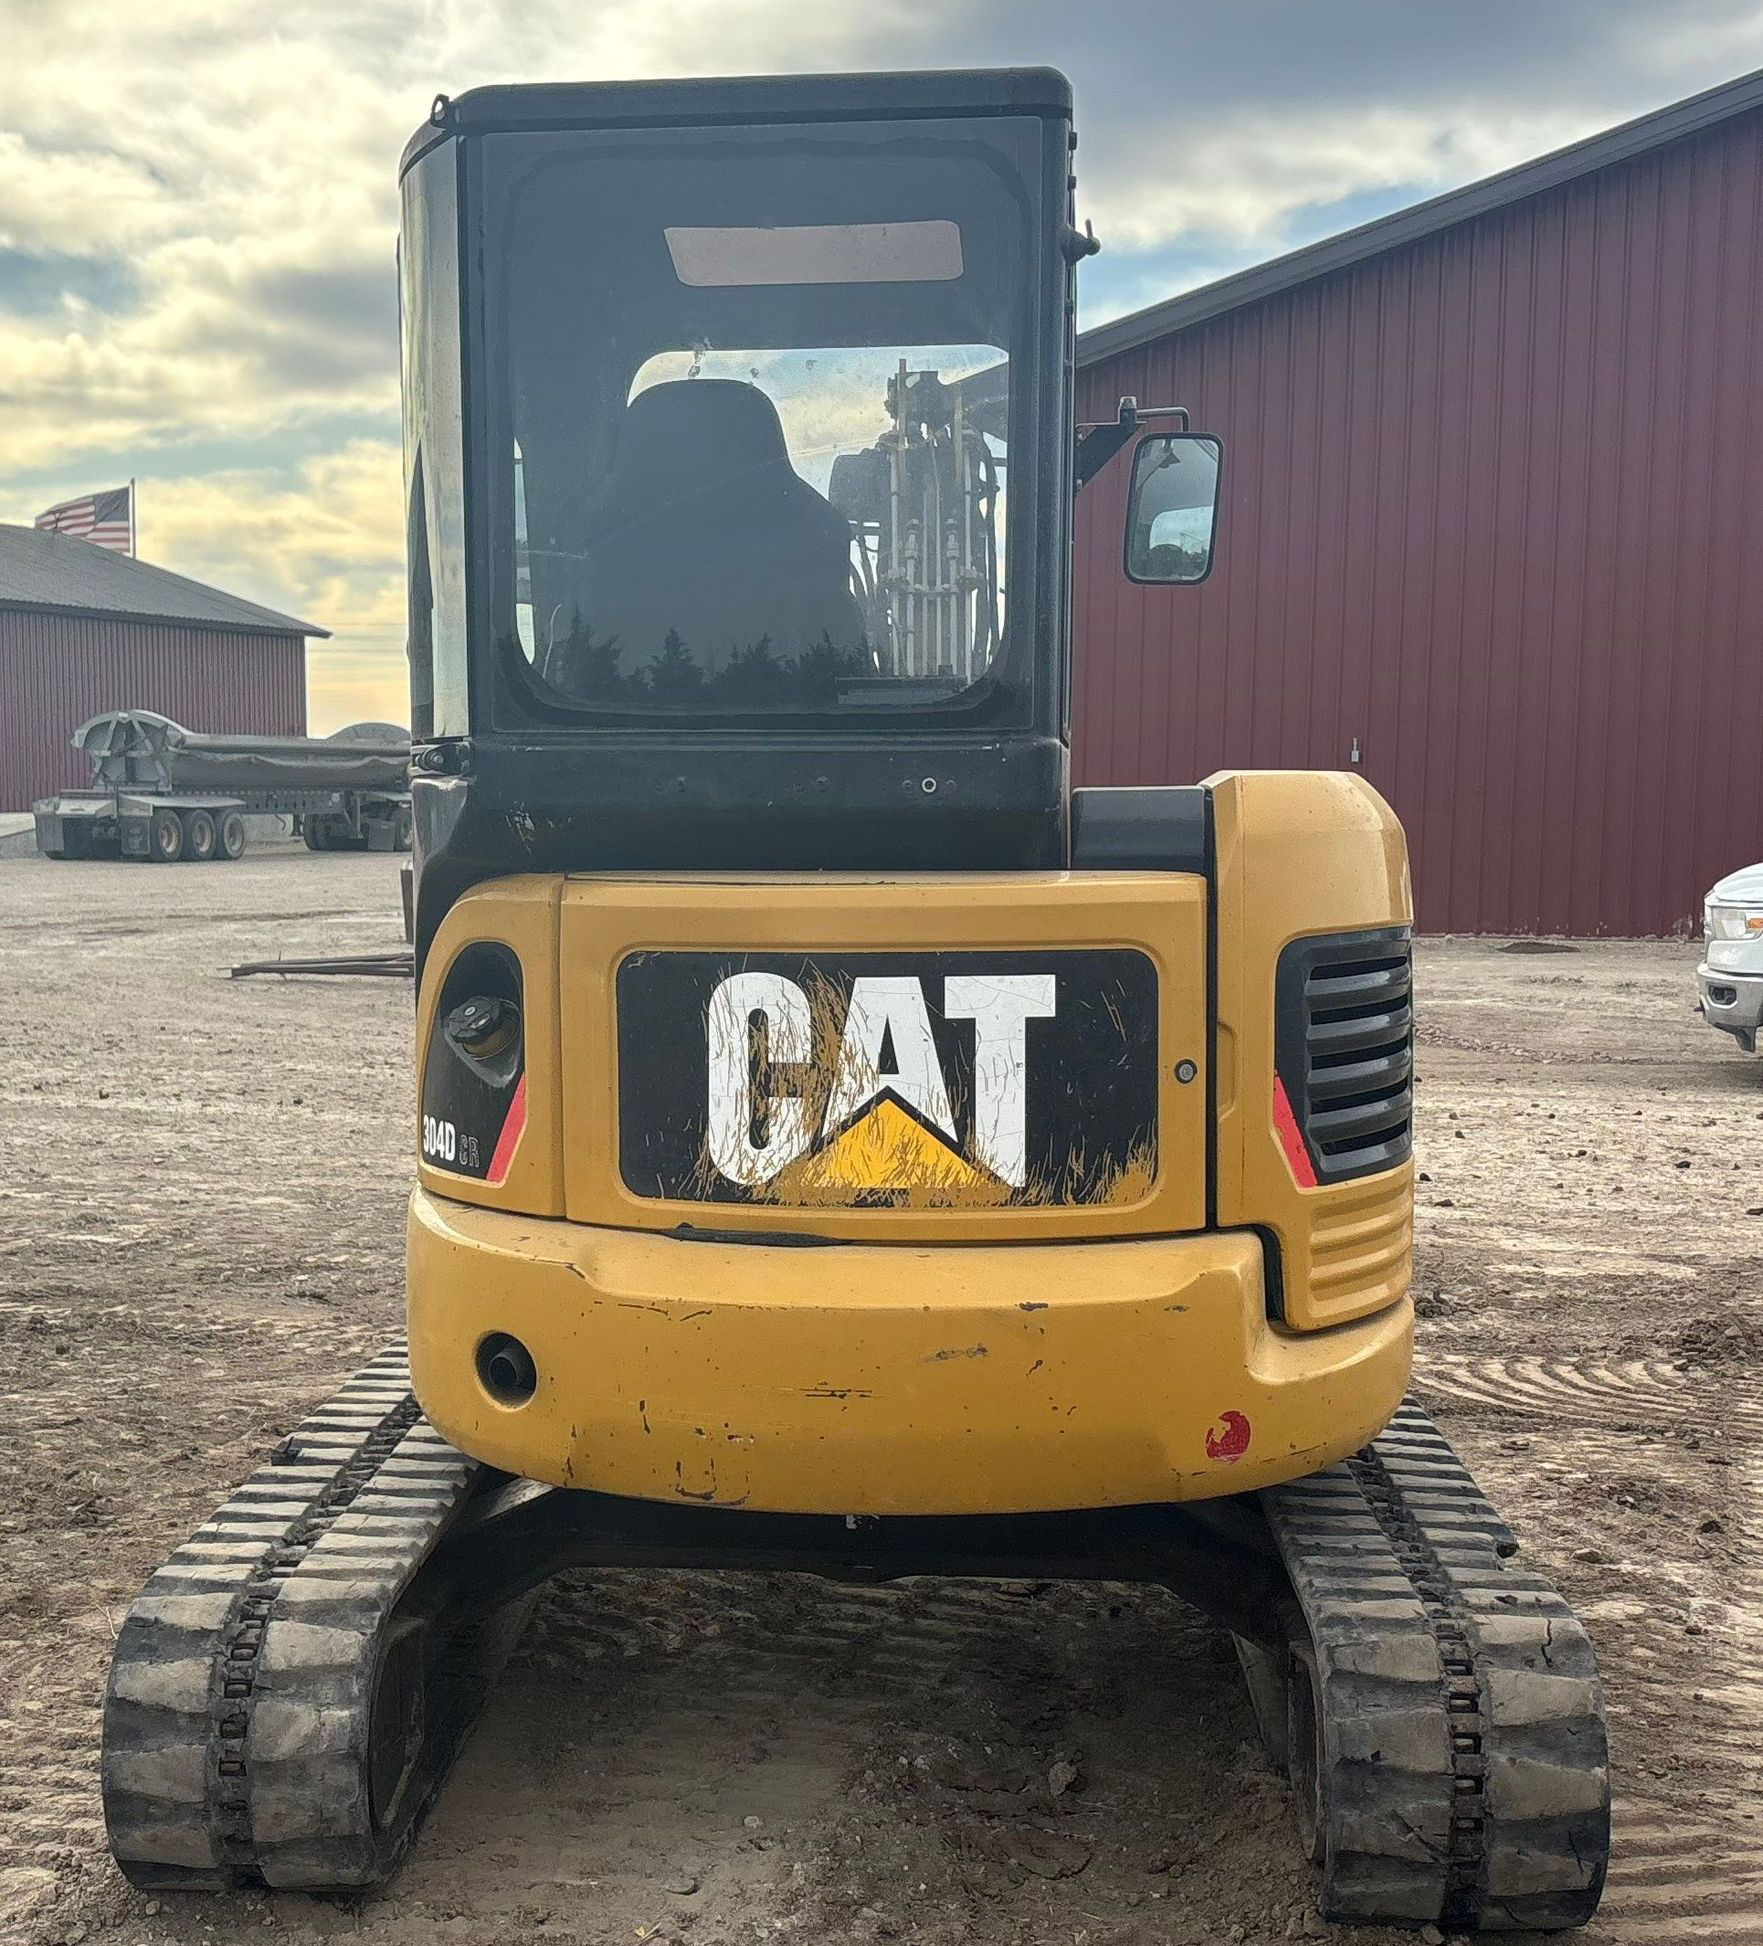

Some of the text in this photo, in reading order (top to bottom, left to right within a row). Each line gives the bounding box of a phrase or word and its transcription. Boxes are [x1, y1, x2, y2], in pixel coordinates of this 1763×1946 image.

[423, 1115, 480, 1168] 304D CR
[708, 972, 1056, 1188] CAT
